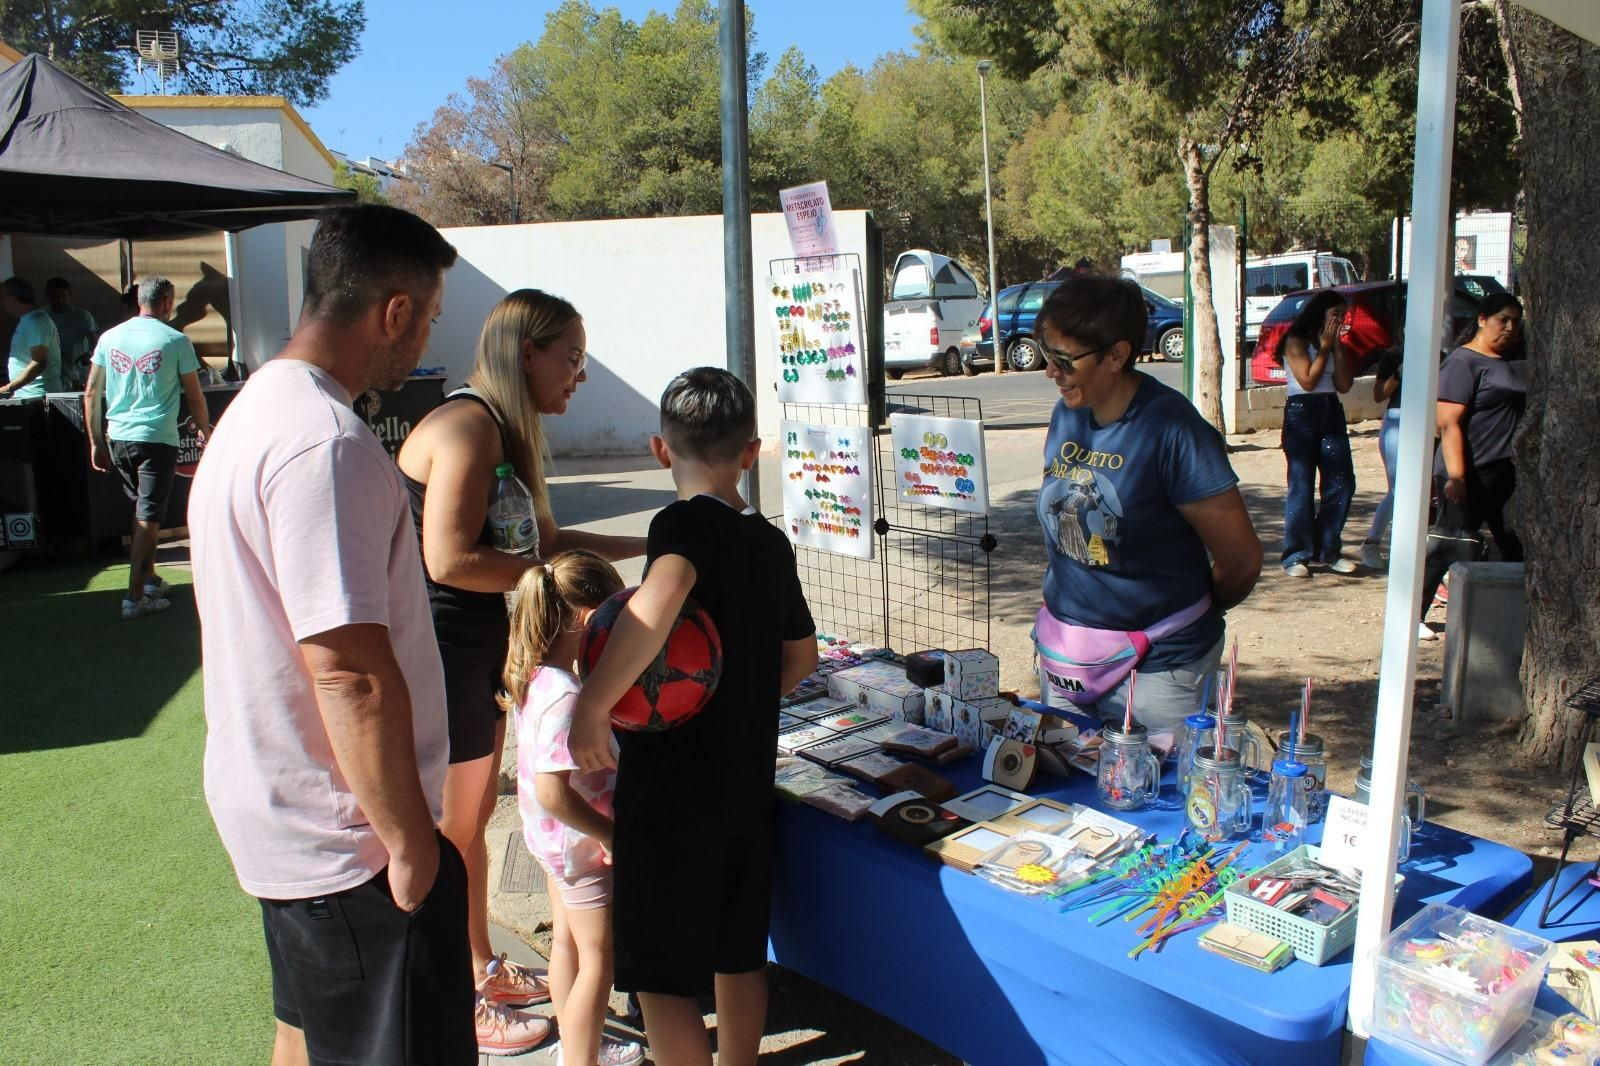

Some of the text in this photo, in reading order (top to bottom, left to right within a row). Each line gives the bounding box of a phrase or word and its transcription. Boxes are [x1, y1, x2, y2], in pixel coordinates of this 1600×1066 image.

[786, 197, 825, 213] METACRILATO
[796, 208, 818, 221] ESPEJO
[176, 448, 203, 464] Galic
[1045, 669, 1086, 693] BULMA
[1342, 833, 1358, 847] 1€
[1251, 879, 1286, 901] H
